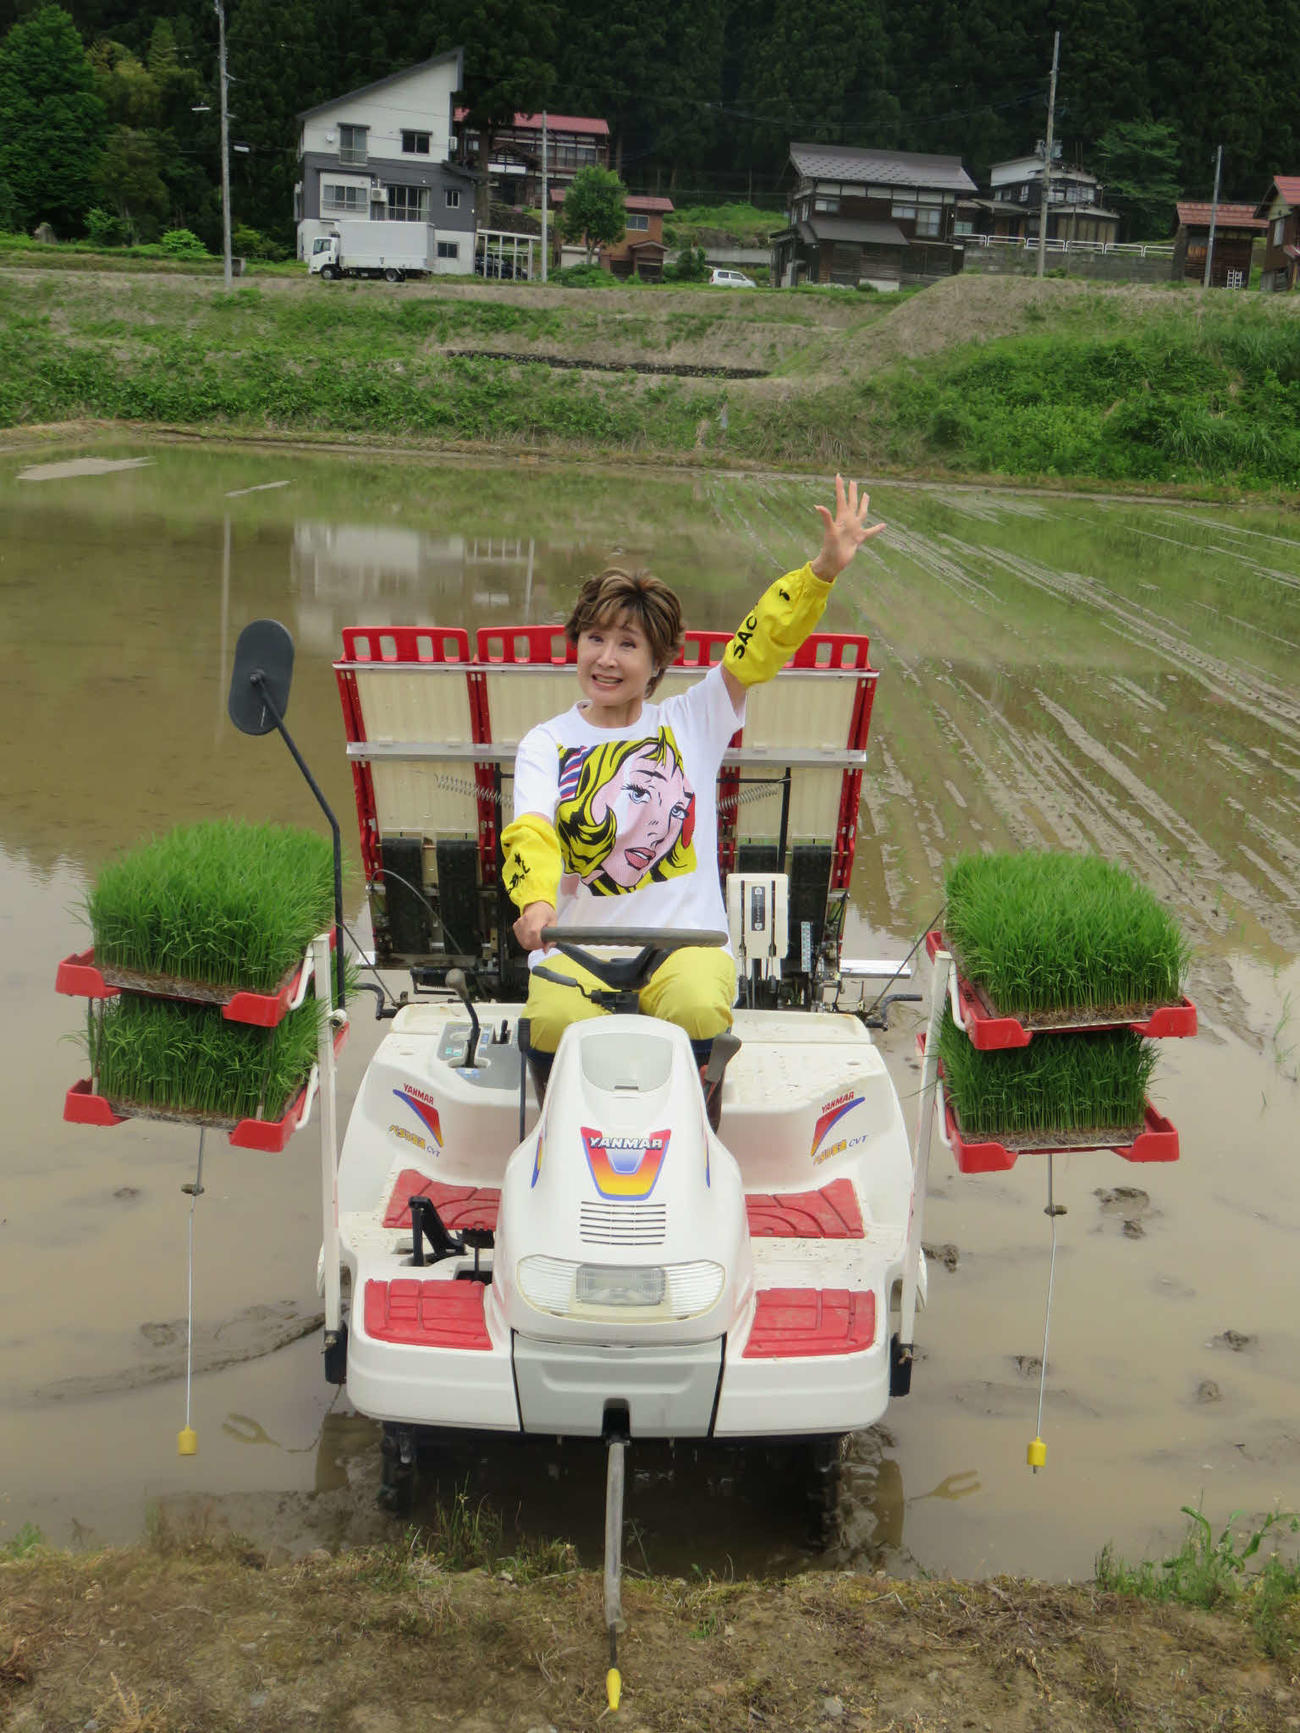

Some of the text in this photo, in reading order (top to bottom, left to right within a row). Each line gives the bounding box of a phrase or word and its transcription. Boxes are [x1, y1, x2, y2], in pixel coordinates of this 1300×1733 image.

[403, 1083, 435, 1105] YANMAR
[821, 1091, 855, 1114] YANMAR
[589, 1136, 663, 1150] YANMAR
